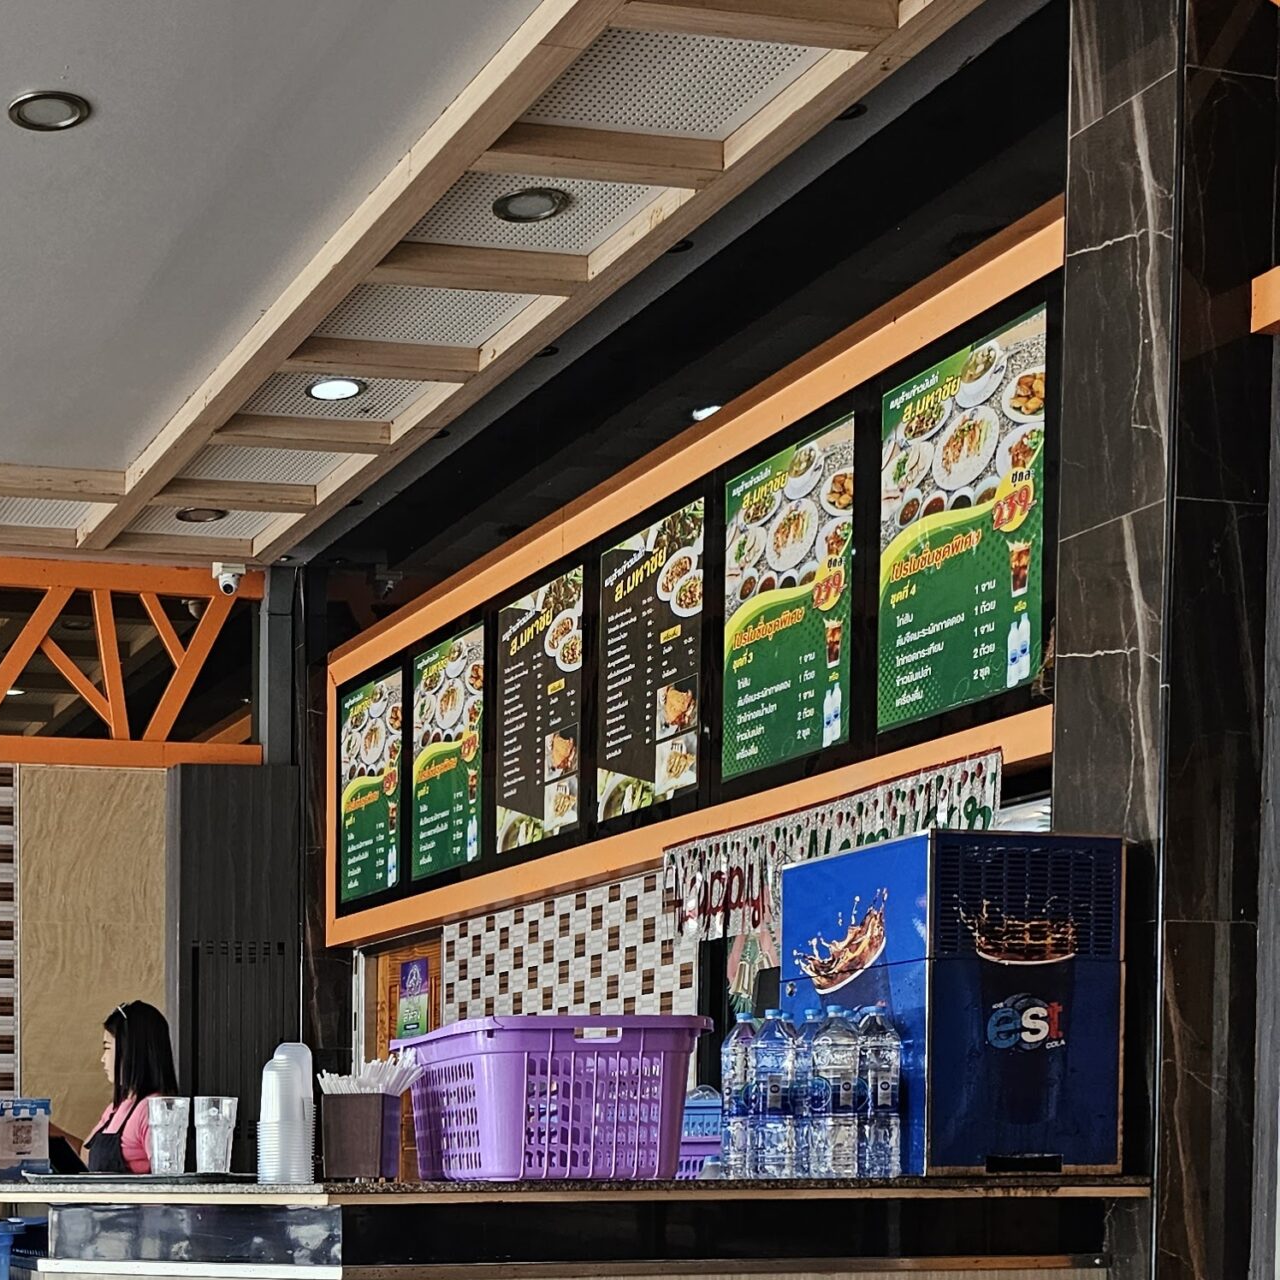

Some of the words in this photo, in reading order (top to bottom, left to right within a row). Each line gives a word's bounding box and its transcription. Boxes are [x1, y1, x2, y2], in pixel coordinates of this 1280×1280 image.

[903, 376, 961, 423] ส.มหาชัย
[742, 470, 789, 509] ส.มหาชัย
[614, 547, 667, 603] ส.มหาชัย
[981, 579, 996, 592] จาน
[890, 579, 909, 609] ชุดที่
[909, 585, 917, 596] 4
[510, 607, 553, 656] ส.มหาชัย
[980, 622, 995, 634] จาน
[748, 651, 753, 662] 3
[973, 648, 978, 659] 2
[973, 668, 978, 679] 2
[987, 1001, 1063, 1048] est
[1045, 1039, 1066, 1050] COLA
